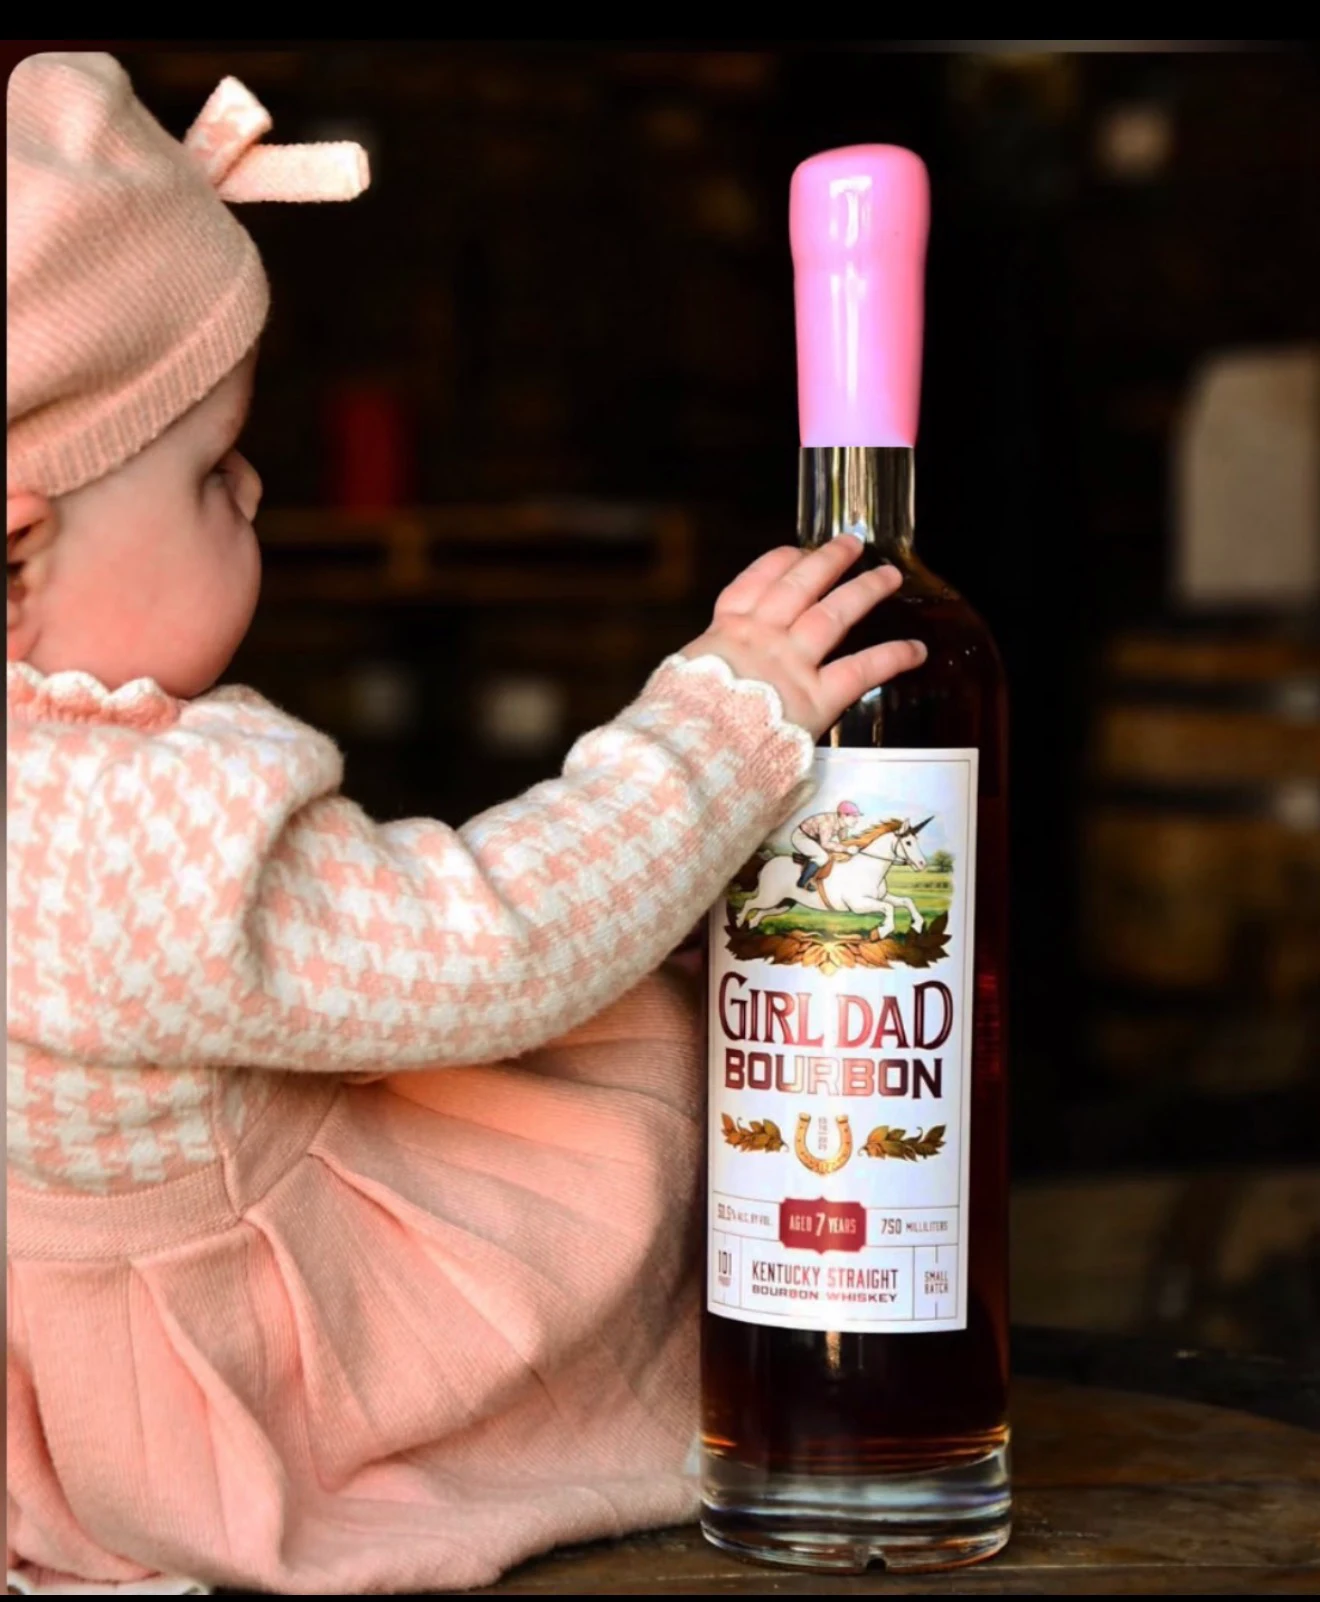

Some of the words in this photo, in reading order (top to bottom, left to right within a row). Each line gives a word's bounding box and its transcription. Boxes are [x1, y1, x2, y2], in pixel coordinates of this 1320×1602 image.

[718, 971, 825, 1047] GIRL
[836, 979, 954, 1050] DAD
[724, 1047, 943, 1100] BOURBON
[789, 1214, 812, 1233] AGED
[815, 1212, 827, 1237] 7
[828, 1216, 857, 1235] YEARS
[881, 1218, 903, 1235] 750
[718, 1249, 732, 1276] 101
[751, 1259, 821, 1287] KENTUCKY
[826, 1265, 899, 1290] STRAIGHT
[924, 1270, 949, 1282] SMALL
[924, 1282, 949, 1295] BATCH
[751, 1284, 819, 1301] BOURBON
[825, 1290, 898, 1304] WHISKEY
